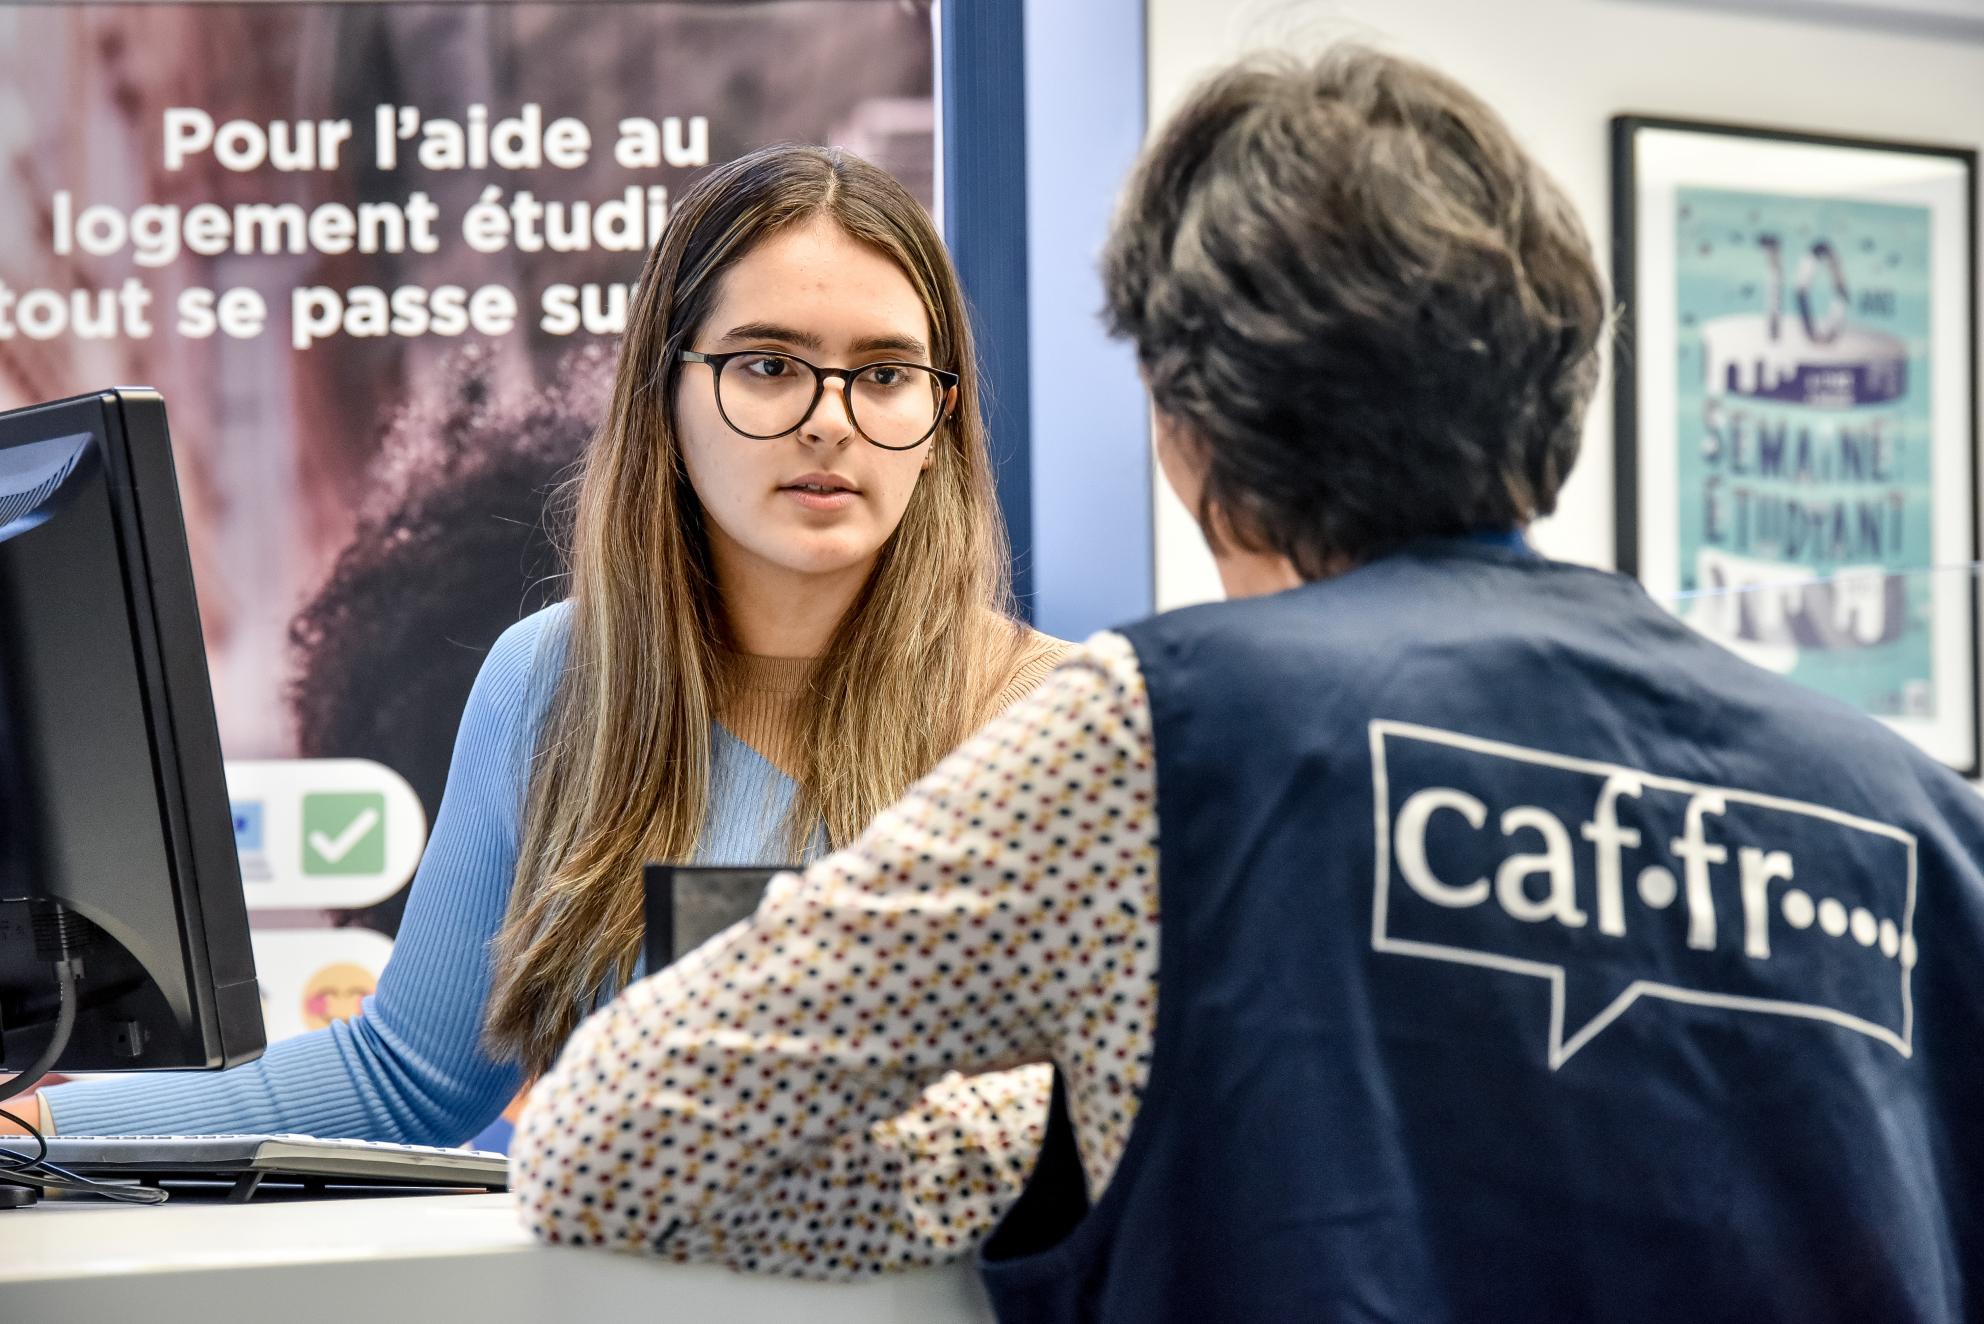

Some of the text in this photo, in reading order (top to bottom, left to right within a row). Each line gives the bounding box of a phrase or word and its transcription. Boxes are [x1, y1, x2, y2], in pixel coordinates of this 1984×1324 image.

[163, 104, 709, 171] Pour l’aide au
[52, 184, 669, 268] logement étudi
[176, 286, 267, 340] se
[292, 284, 518, 350] passe
[541, 283, 640, 335] su
